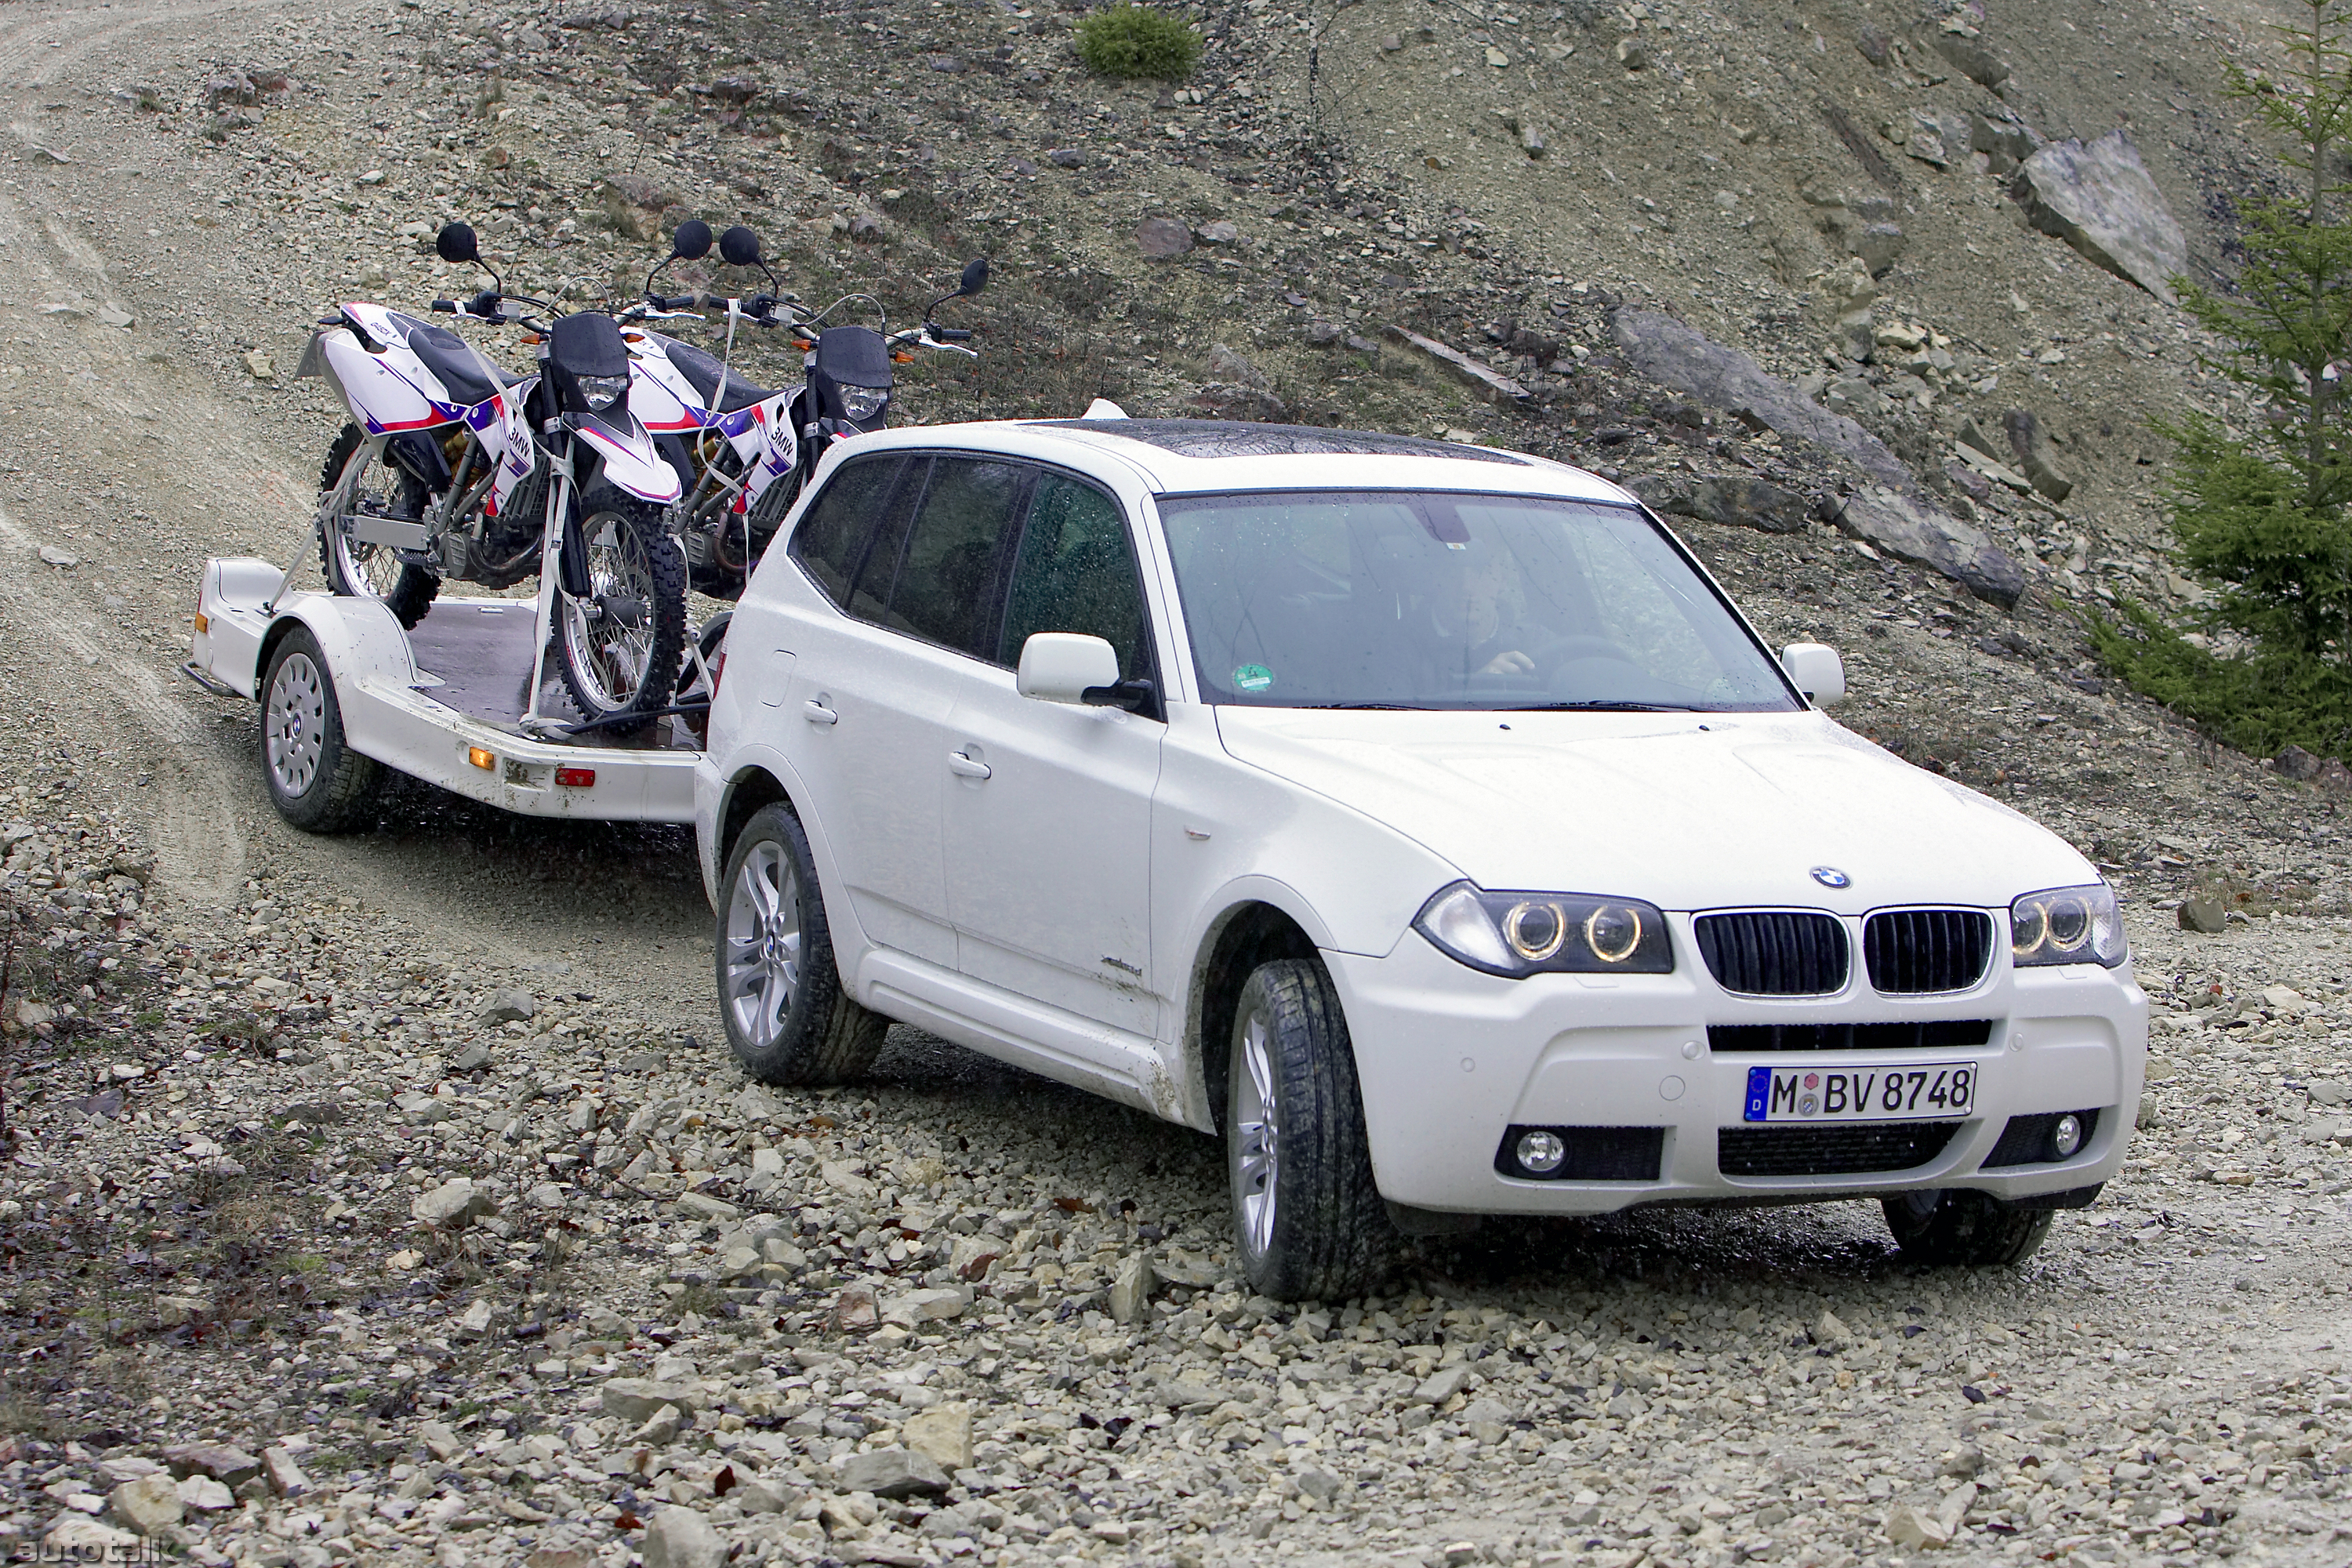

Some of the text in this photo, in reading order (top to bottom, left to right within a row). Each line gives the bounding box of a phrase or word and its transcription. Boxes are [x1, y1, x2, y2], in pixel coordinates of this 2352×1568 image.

[1751, 1069, 1970, 1113] D M BV 8748
